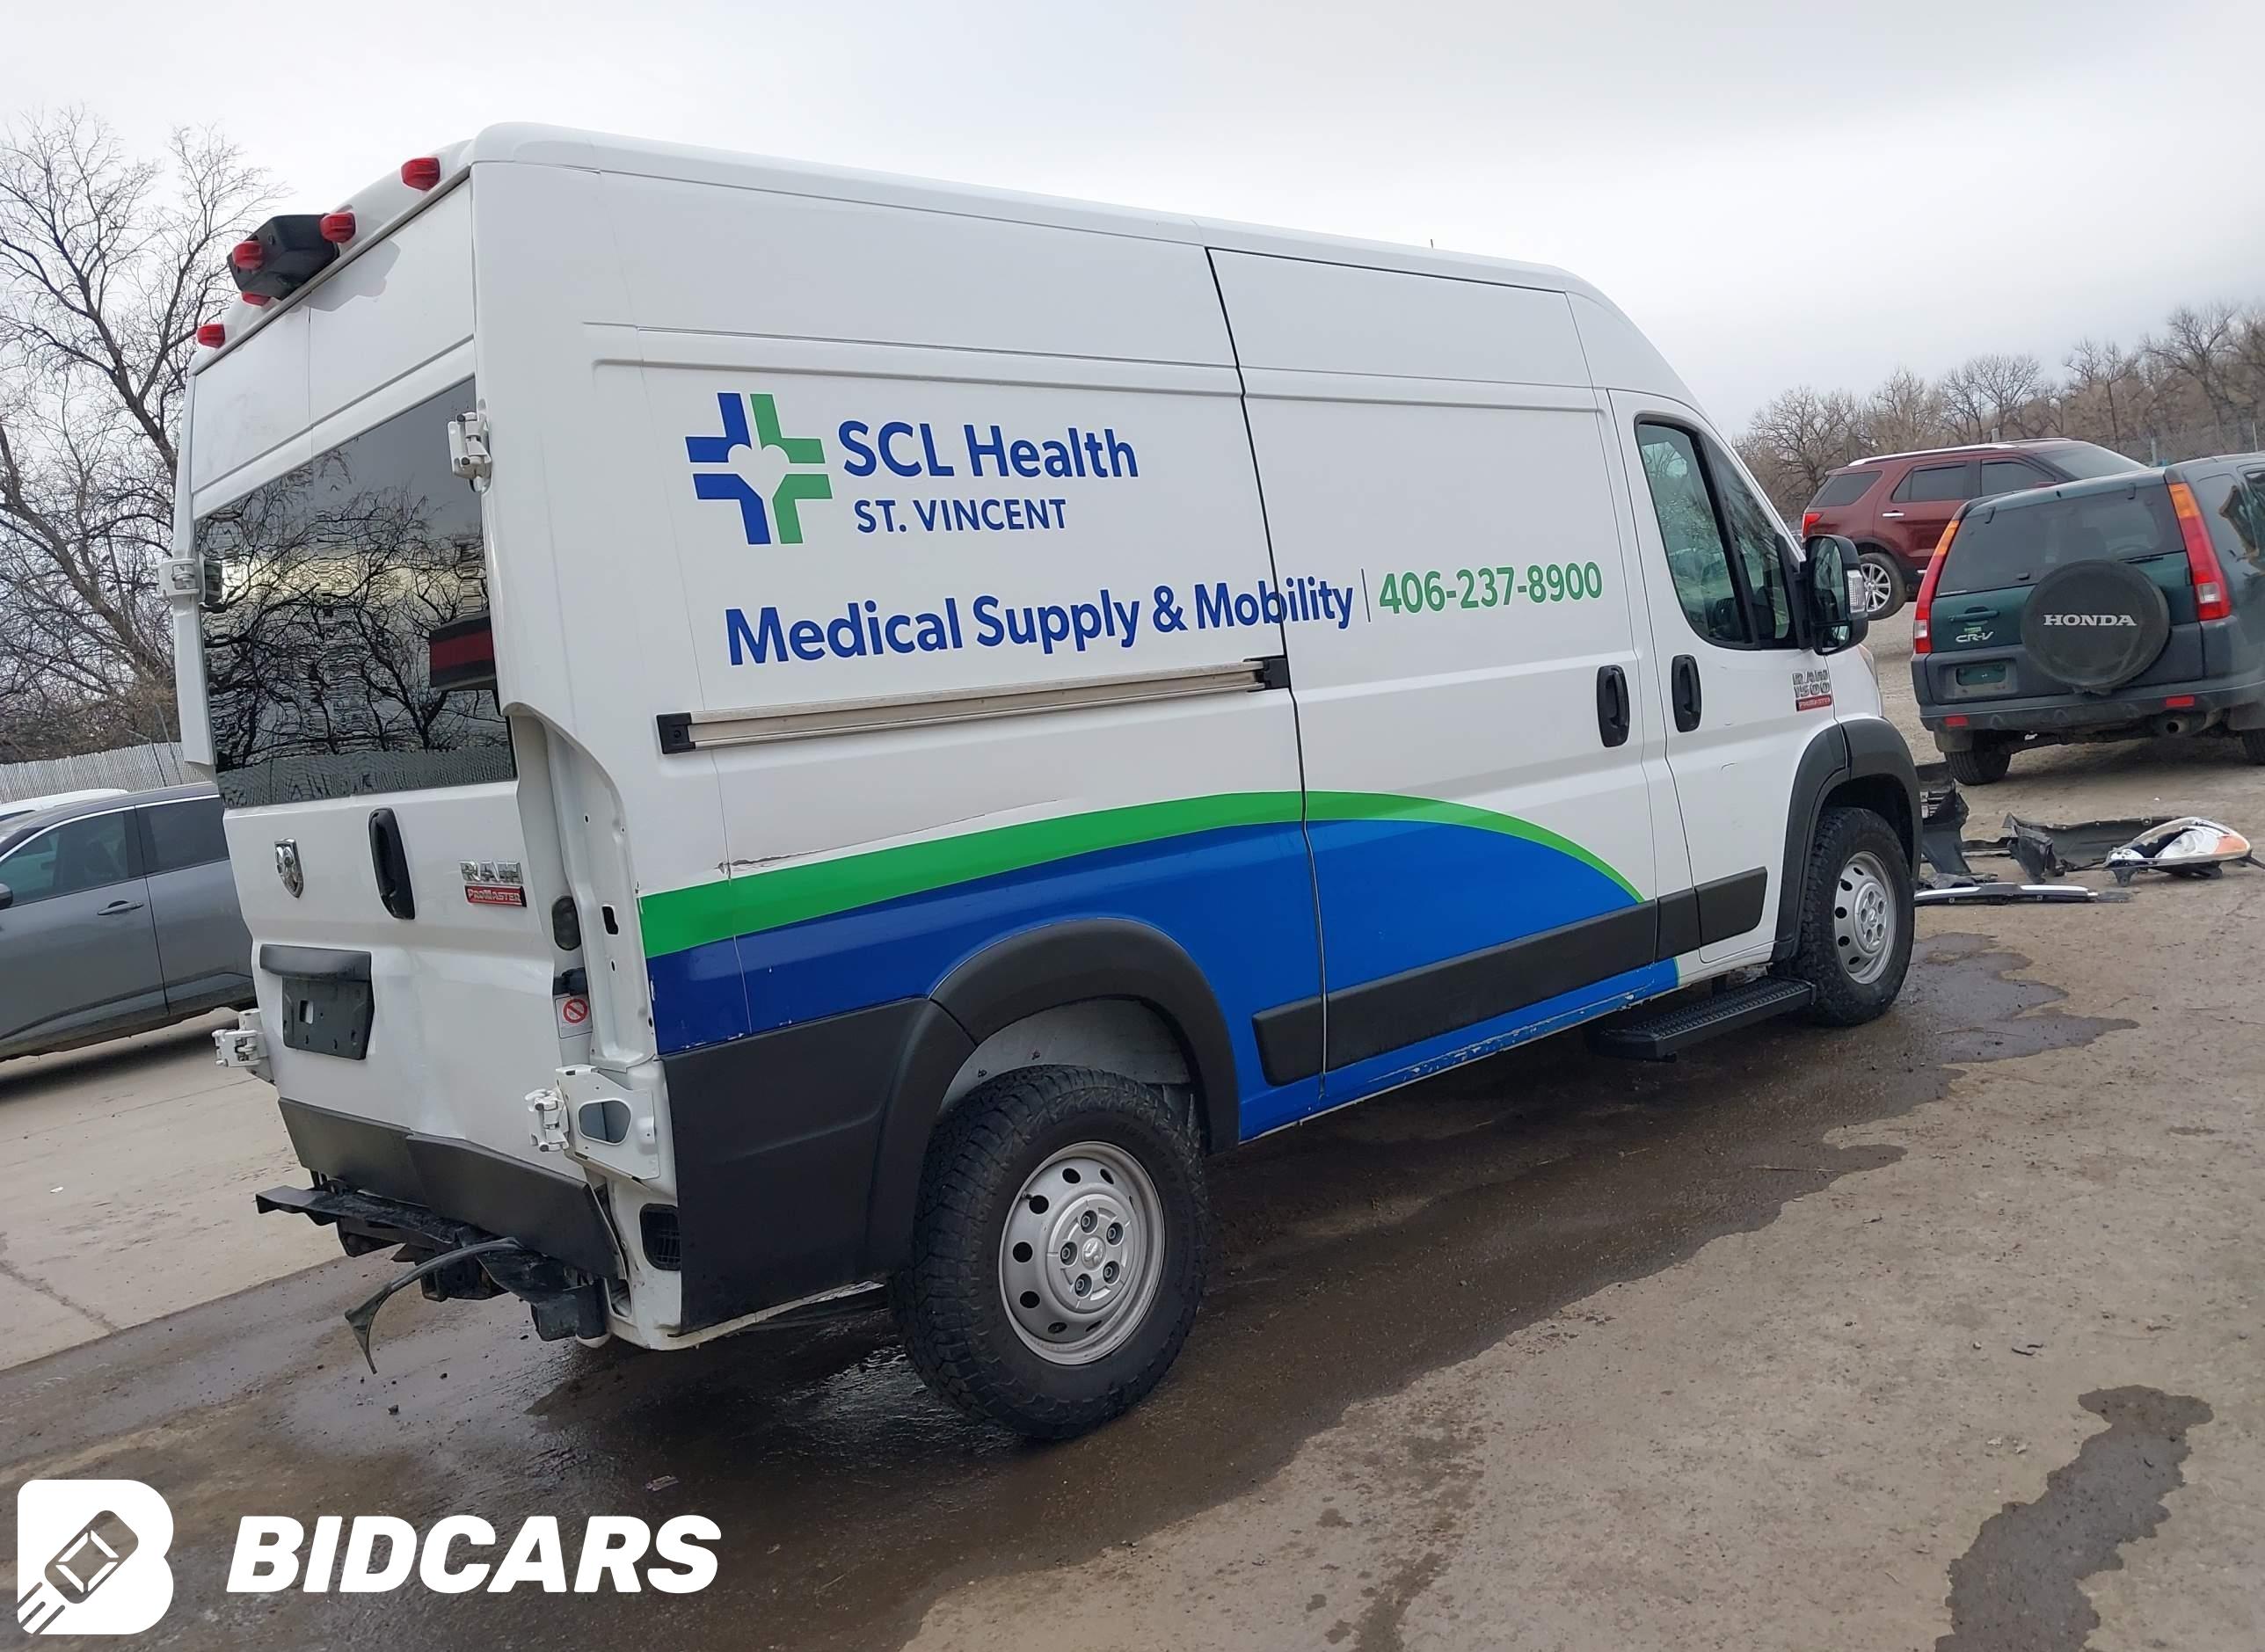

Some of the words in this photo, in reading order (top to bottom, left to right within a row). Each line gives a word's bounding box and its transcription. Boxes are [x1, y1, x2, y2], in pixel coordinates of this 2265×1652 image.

[838, 418, 955, 478] SCL
[963, 423, 1140, 479] Health
[854, 499, 907, 534] ST.
[913, 498, 1067, 532] VINCENT
[1379, 561, 1603, 615] 406-237-8900
[725, 597, 964, 666] Medical
[972, 588, 1140, 655] Supply
[1152, 585, 1189, 633] &
[1193, 576, 1354, 630] Mobility
[2043, 614, 2138, 627] HONDA
[1955, 631, 1994, 643] CR-V
[1792, 669, 1830, 686] RAM
[1794, 681, 1831, 698] 1500
